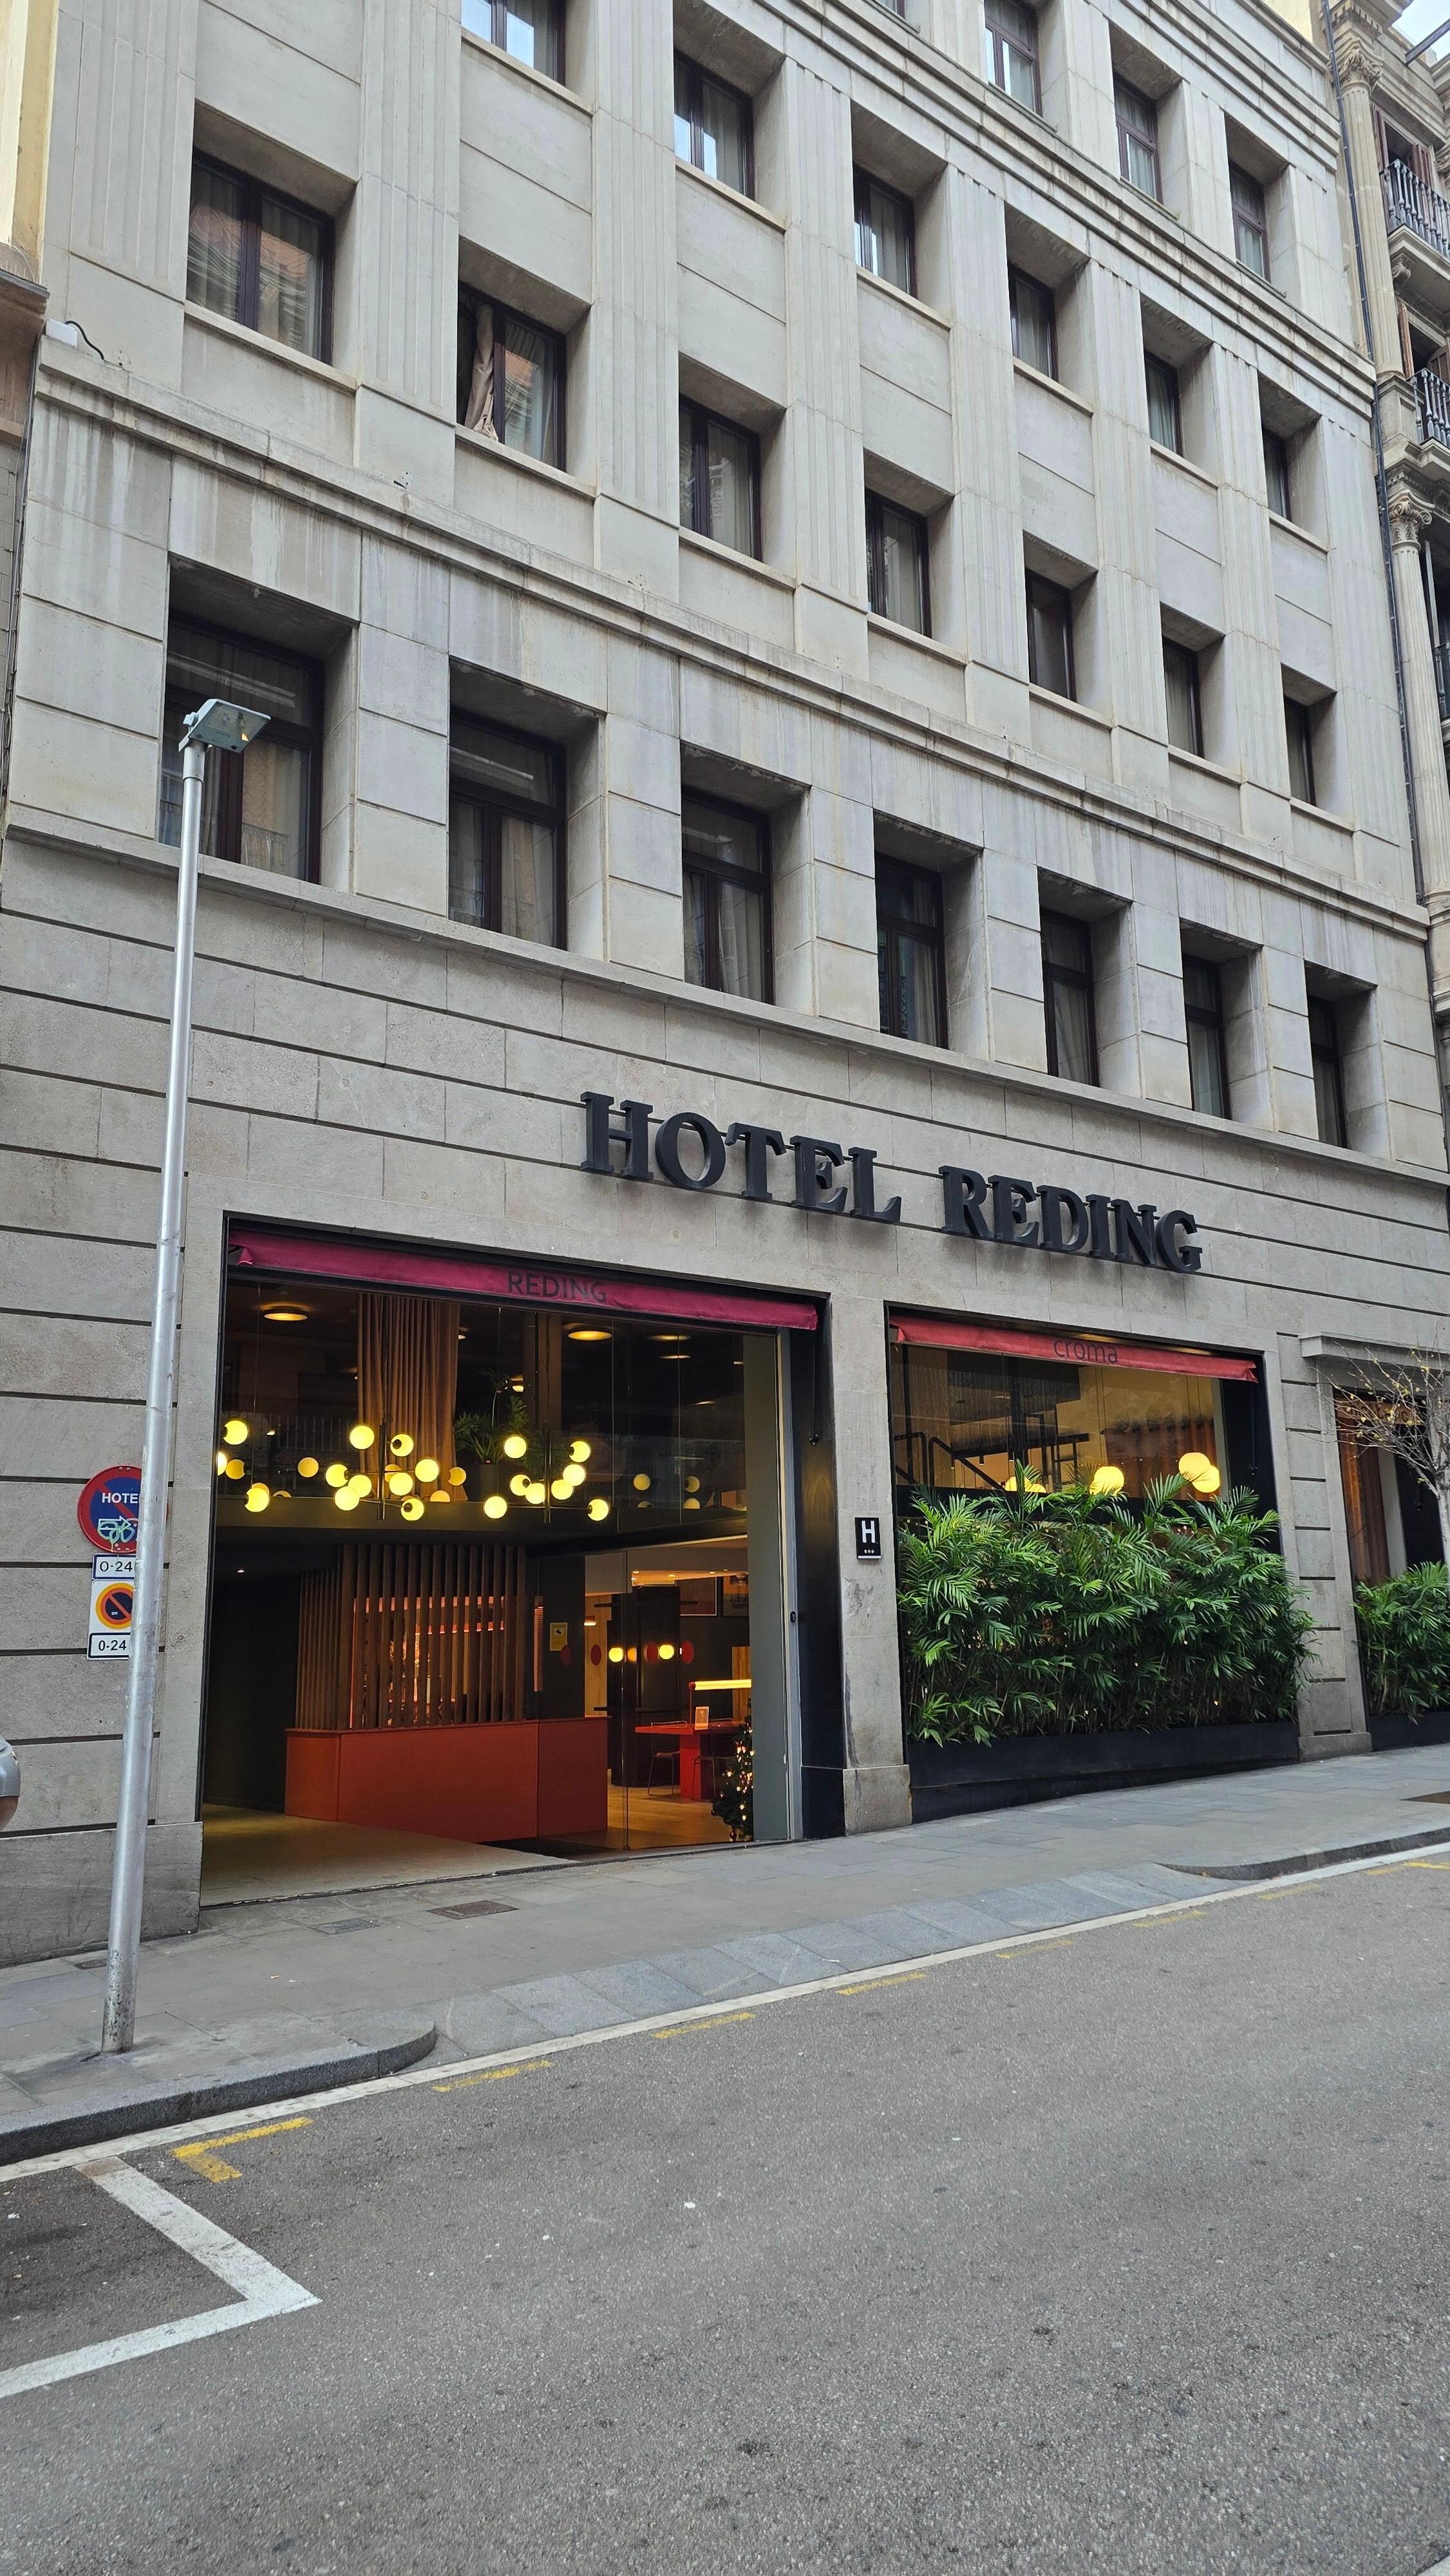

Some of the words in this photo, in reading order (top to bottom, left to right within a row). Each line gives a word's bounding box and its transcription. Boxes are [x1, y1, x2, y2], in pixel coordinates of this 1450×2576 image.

[580, 1091, 901, 1223] HOTEL
[938, 1164, 1203, 1273] REDING
[507, 1271, 607, 1303] REDING
[1053, 1339, 1118, 1364] croma
[102, 1492, 140, 1504] HOTE
[862, 1520, 876, 1543] H
[98, 1640, 127, 1651] 0-24
